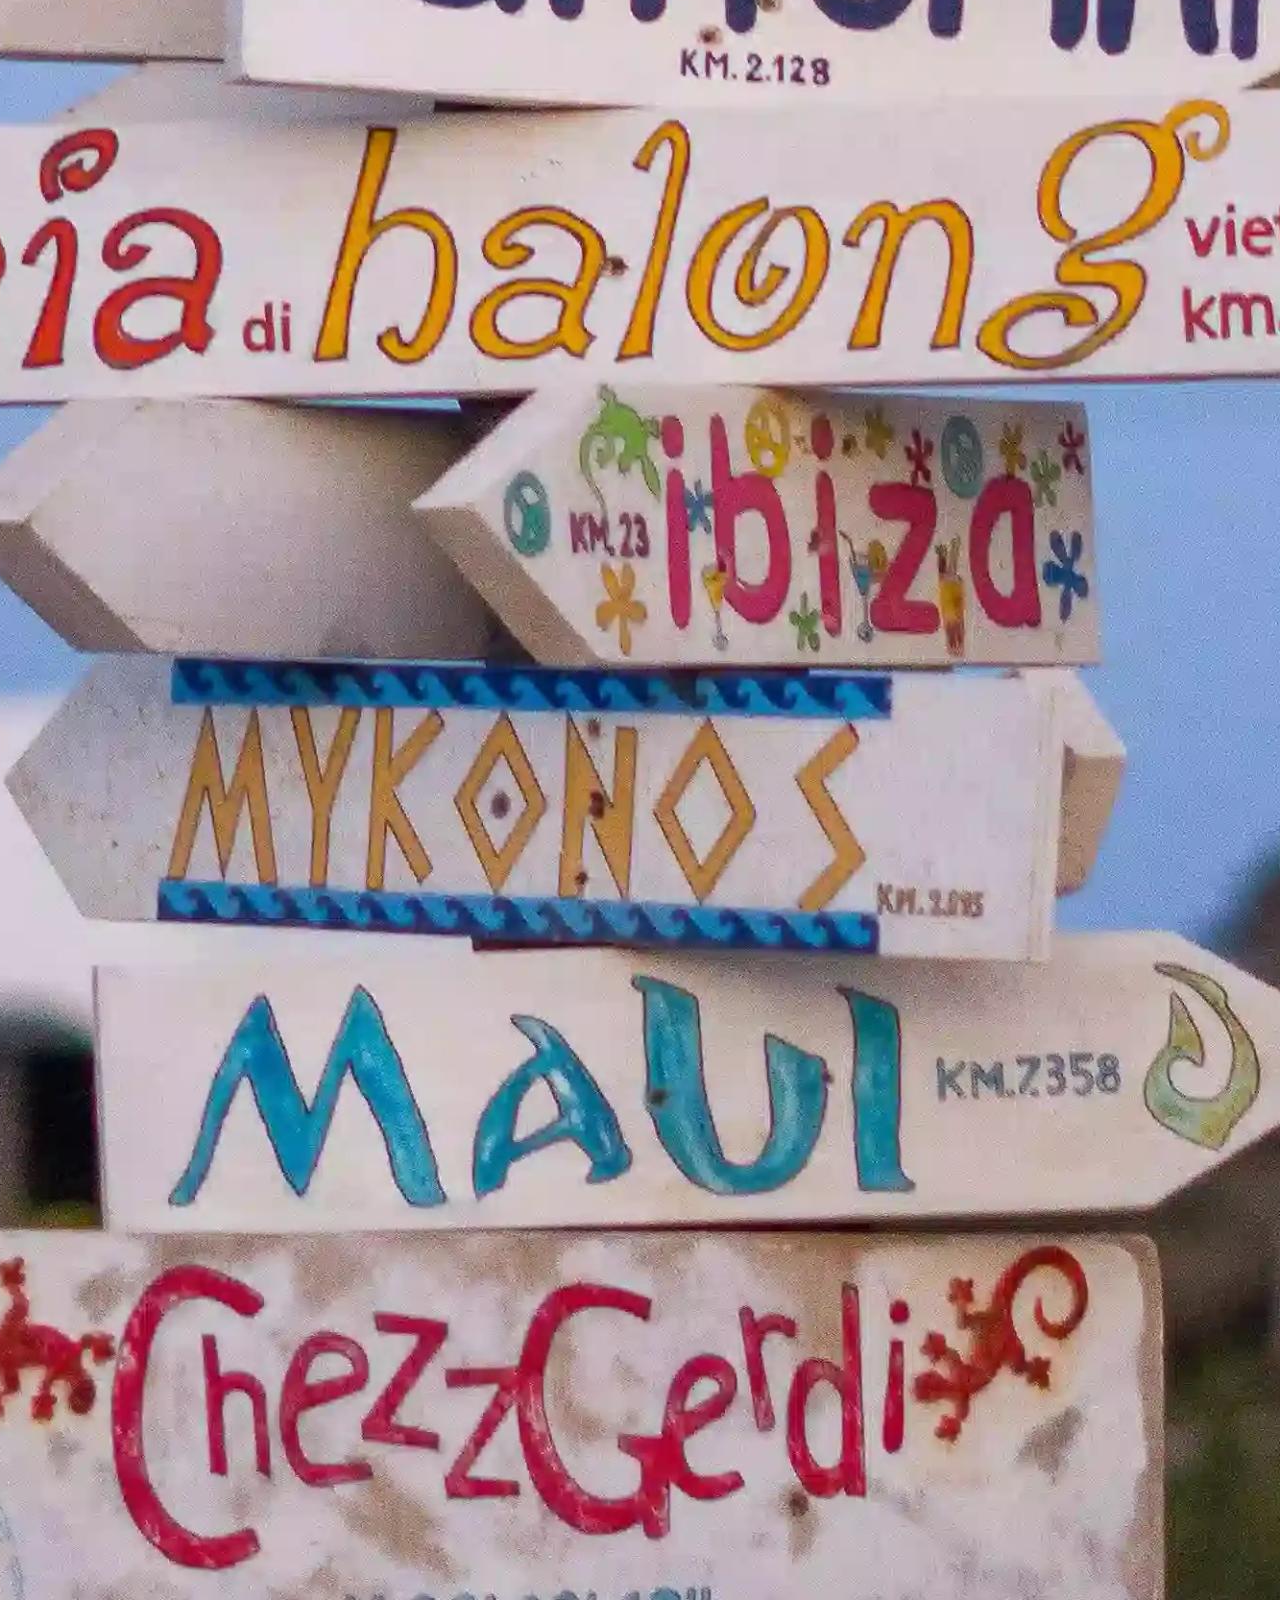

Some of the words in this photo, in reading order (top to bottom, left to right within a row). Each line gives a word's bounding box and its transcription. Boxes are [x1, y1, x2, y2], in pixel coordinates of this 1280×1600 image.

[242, 302, 293, 354] di
[312, 97, 1232, 371] halong
[661, 412, 1043, 640] ibiza
[167, 704, 869, 912] MYKONOS
[168, 973, 917, 1206] MAUI
